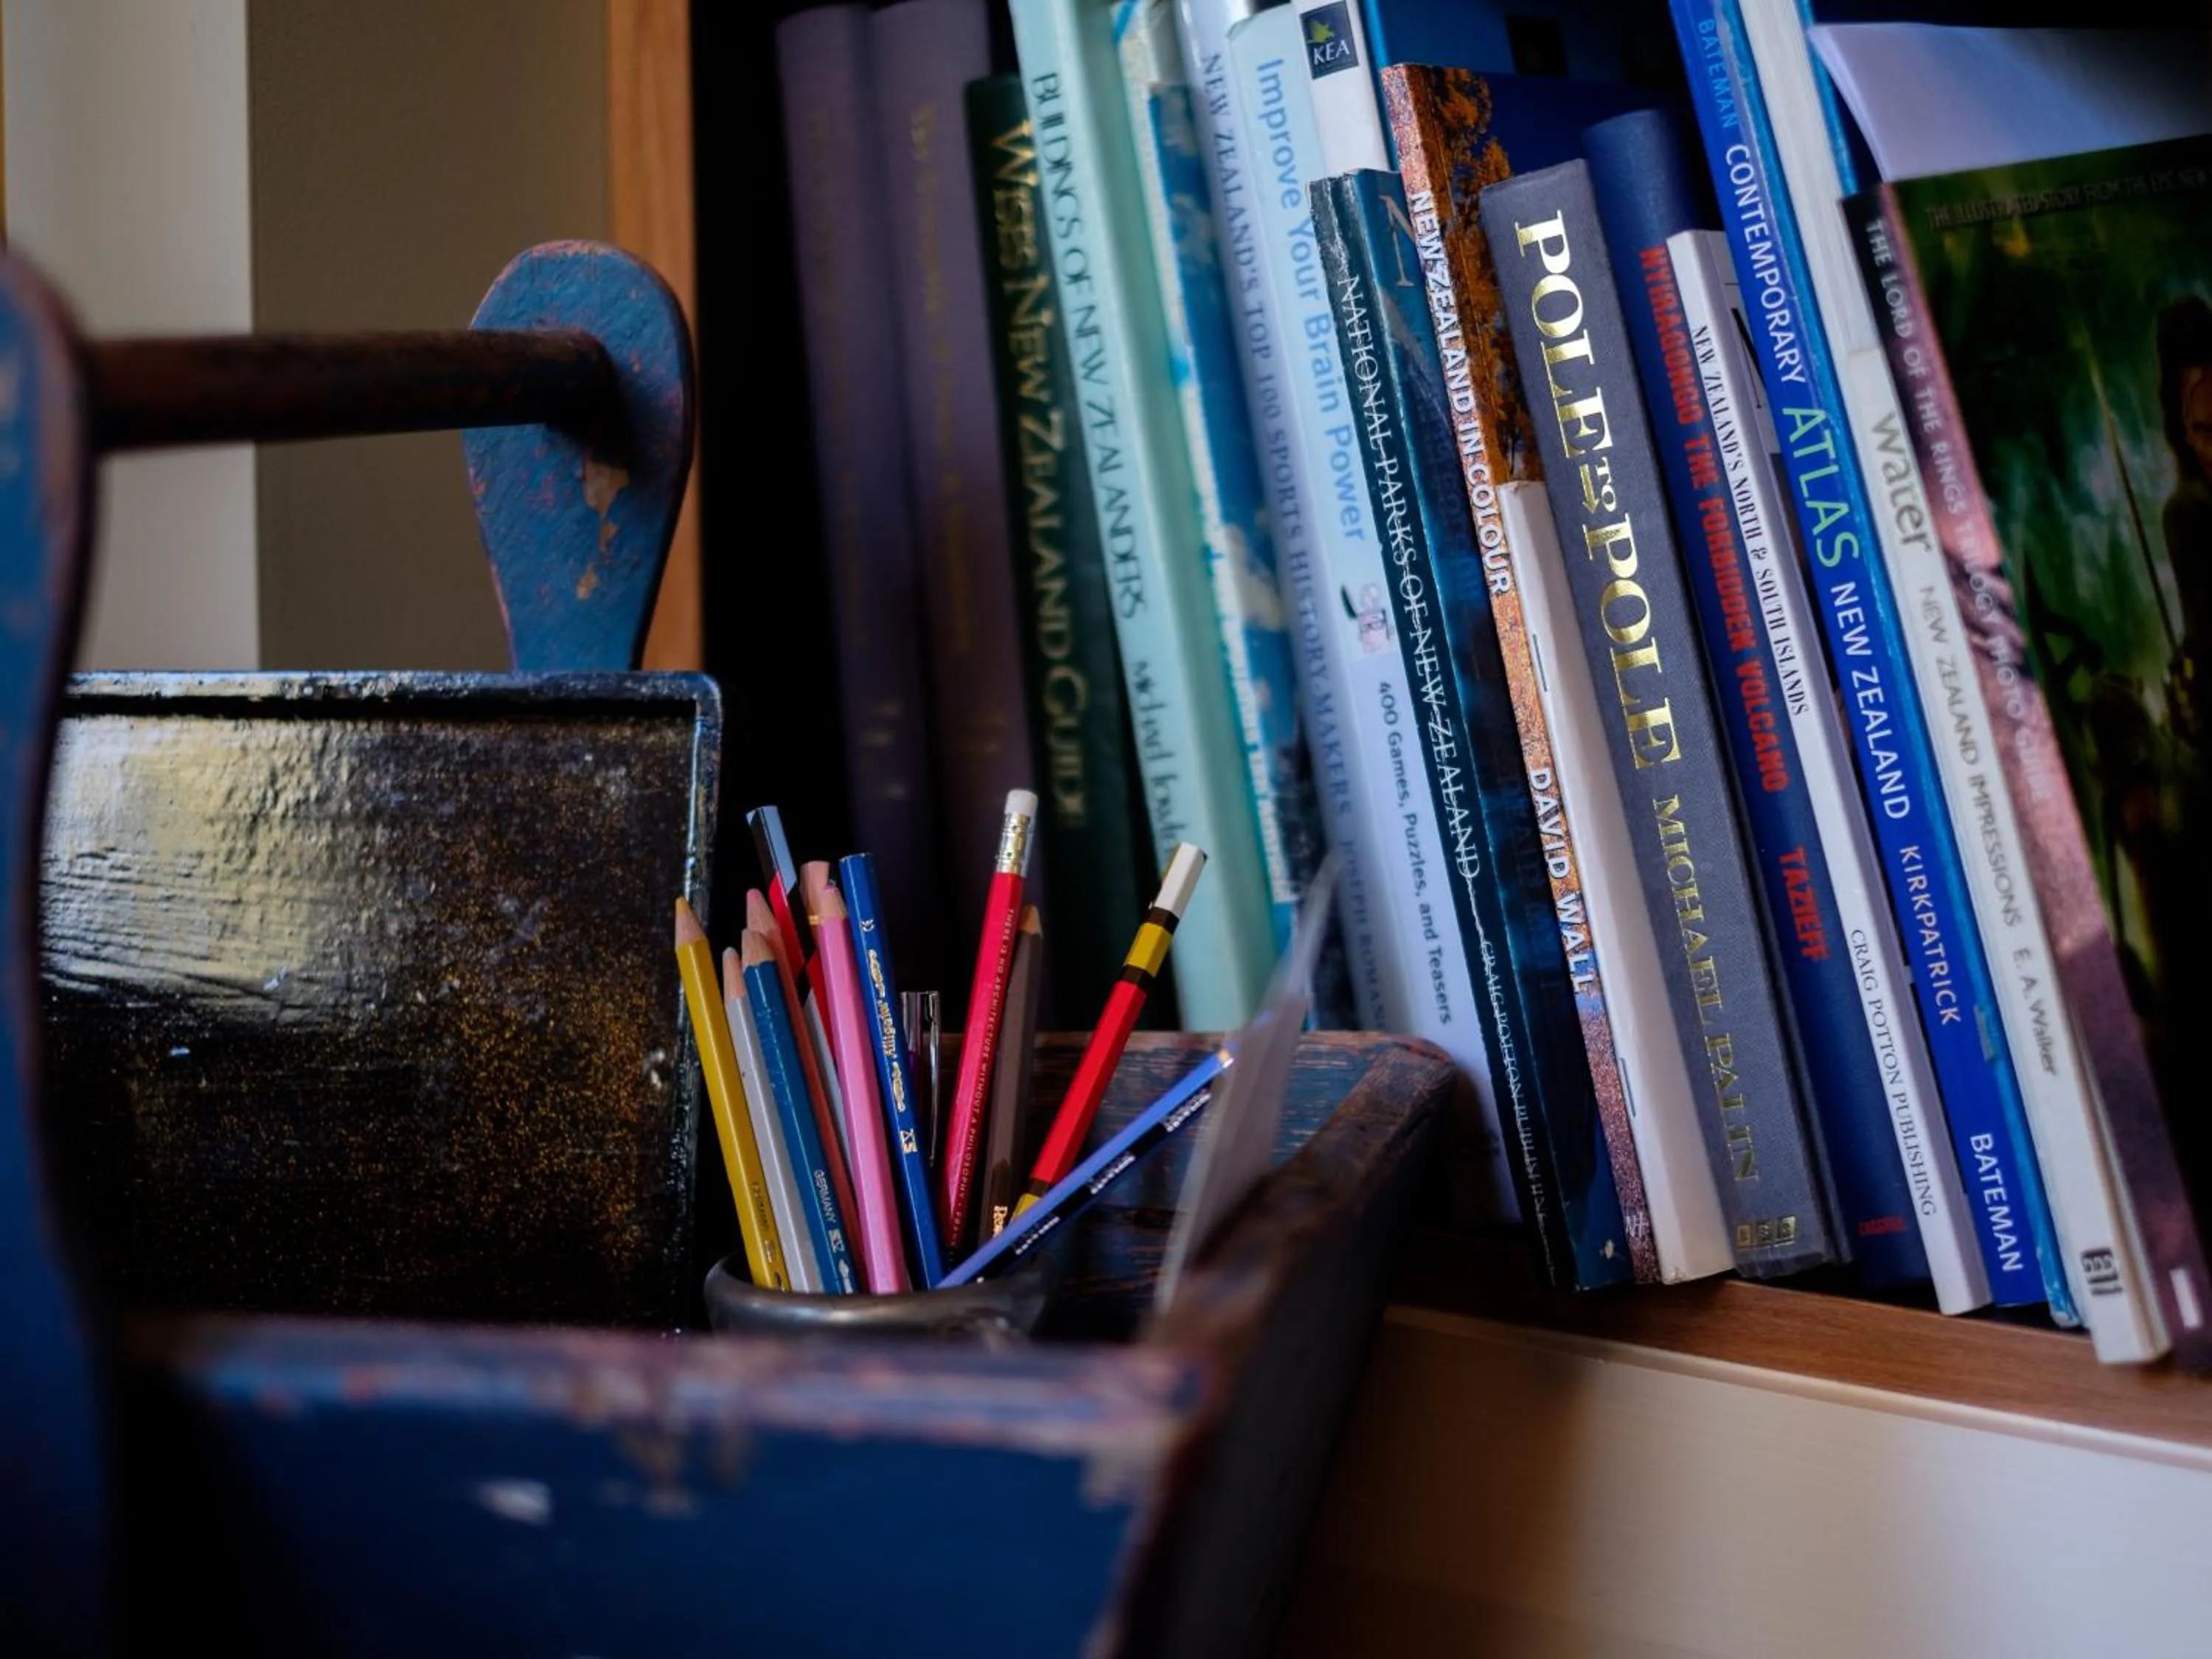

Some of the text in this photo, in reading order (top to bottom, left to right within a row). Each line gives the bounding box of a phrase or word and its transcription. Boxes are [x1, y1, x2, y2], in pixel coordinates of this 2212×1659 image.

[1202, 53, 1230, 116] NEW
[1313, 39, 1350, 65] KEA
[1700, 19, 1739, 128] BATEMAN
[1214, 131, 1259, 293] ZEALAND'S
[1865, 220, 1893, 266] THE
[1061, 248, 1092, 296] OF
[1255, 59, 1365, 542] Improve Your Brain Power
[1726, 144, 1806, 384] CONTEMPORARY
[1880, 275, 1915, 338] LORD
[1072, 305, 1109, 388] NEW
[1244, 302, 1273, 360] TOP
[1693, 327, 1716, 364] NEW
[1902, 347, 1927, 379] OF
[1258, 374, 1281, 420] 100
[1412, 189, 1514, 595] NEW ZEALAND IN COLOUR
[1704, 372, 1744, 470] ZEALAND'S
[1914, 389, 1941, 432] THE
[1089, 396, 1146, 619] ZEALANDERS
[1266, 430, 1303, 535] SPORTS
[1514, 210, 1682, 770] POLE TO POLE
[1640, 247, 1790, 793] NYIRAGONGO THE FORBIDDEN VOLCANO
[1731, 477, 1762, 539] NORTH
[1783, 406, 1860, 569] ATLAS
[1871, 411, 1933, 555] water
[1933, 442, 1968, 515] RINGS
[1337, 276, 1481, 880] NATIONAL PARKS OF NEW ZEALAND
[1756, 568, 1787, 631] SOUTH
[1774, 637, 1809, 716] ISLANDS
[1832, 582, 1913, 821] NEW ZEALAND
[1918, 586, 2023, 928] NEW ZEALAND IMPRESSIONS
[1377, 680, 1455, 1025] 400 Games, Puzzles, and Teasers
[1529, 768, 1596, 995] DAVID WALL
[999, 944, 1008, 954] IS
[1001, 908, 1014, 941] THERE
[1779, 848, 1830, 961] TAZIEFF
[1900, 846, 1961, 1026] KIRKPATRICK
[995, 957, 1006, 973] NO
[1652, 795, 1759, 1183] MICHAEL PALIN
[2011, 946, 2032, 969] E.
[2028, 1001, 2059, 1077] Walker
[981, 975, 1002, 1058] ARCHITECTURE
[972, 1062, 987, 1113] WITHOUT
[1850, 928, 1938, 1217] CRAIG POTTON PUBLISHING
[813, 1167, 837, 1224] GERMANY
[1971, 1132, 2023, 1272] BATEMAN
